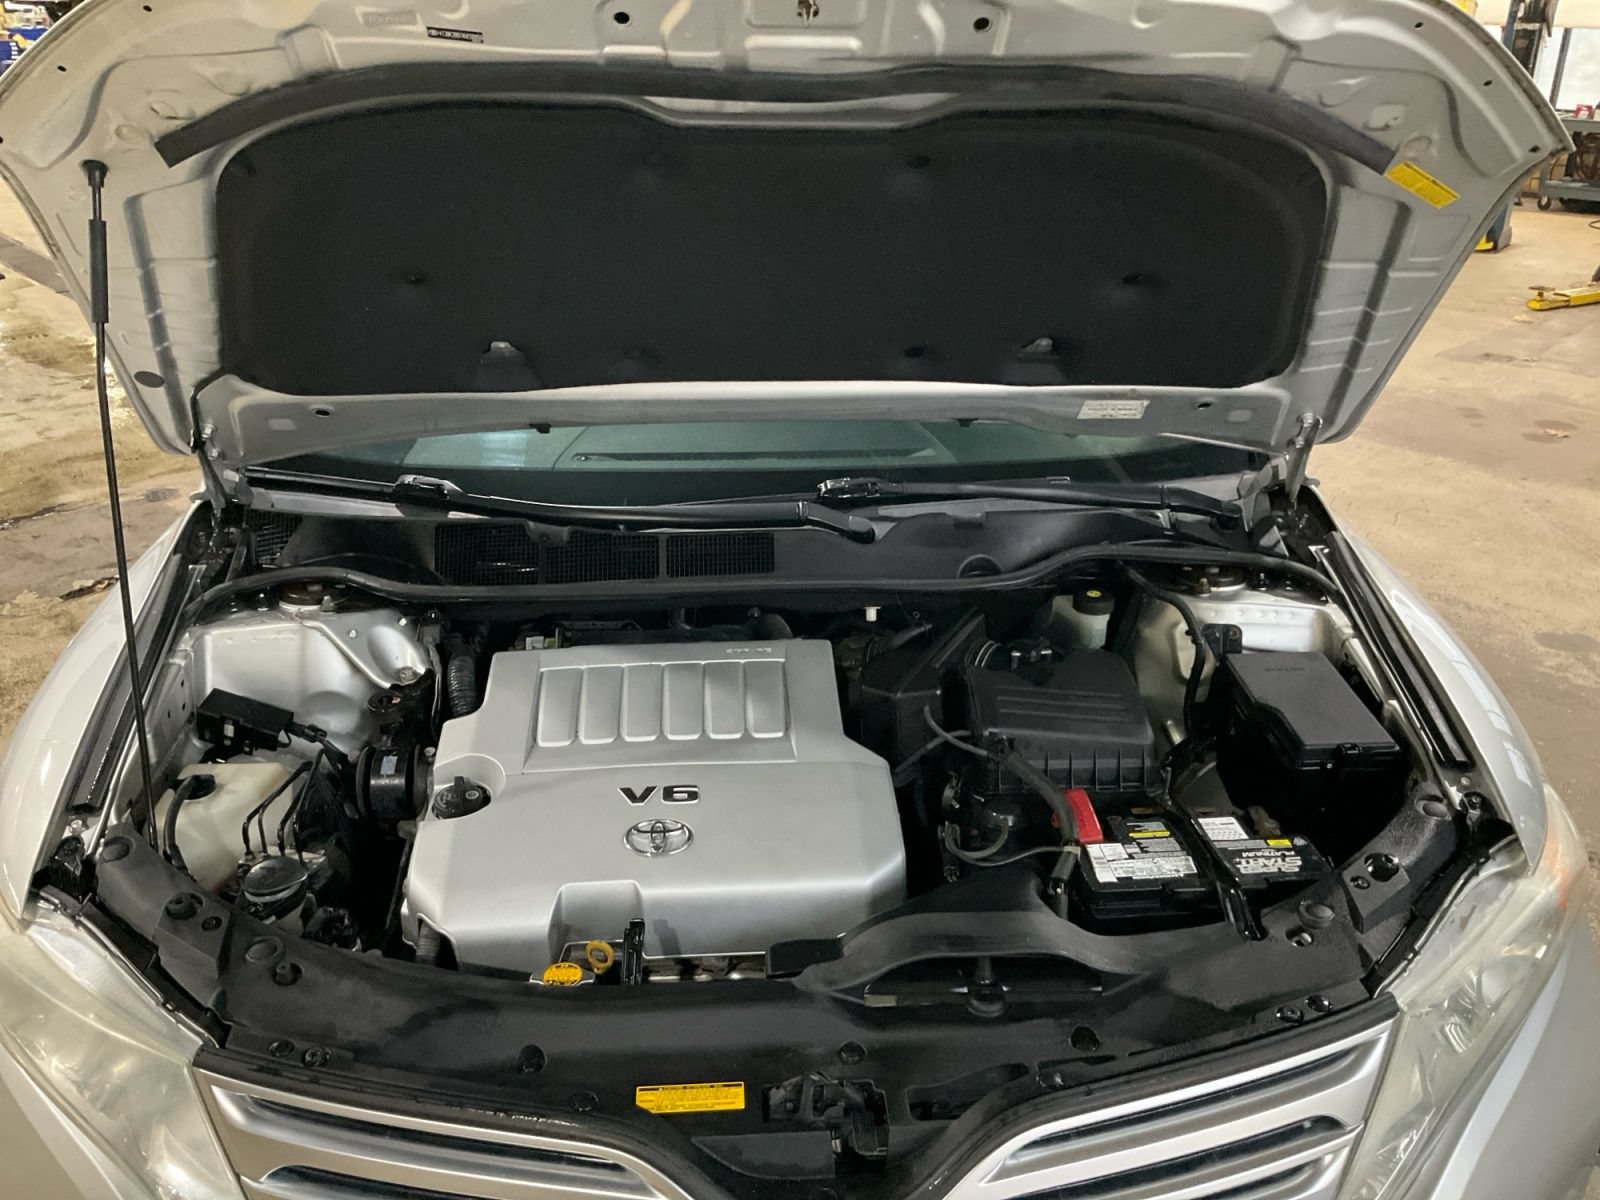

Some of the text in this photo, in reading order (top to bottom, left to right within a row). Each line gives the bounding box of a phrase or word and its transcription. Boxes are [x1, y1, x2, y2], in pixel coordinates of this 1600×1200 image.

[618, 785, 699, 805] V6
[1237, 856, 1302, 867] START
[1239, 864, 1300, 874] SUPER
